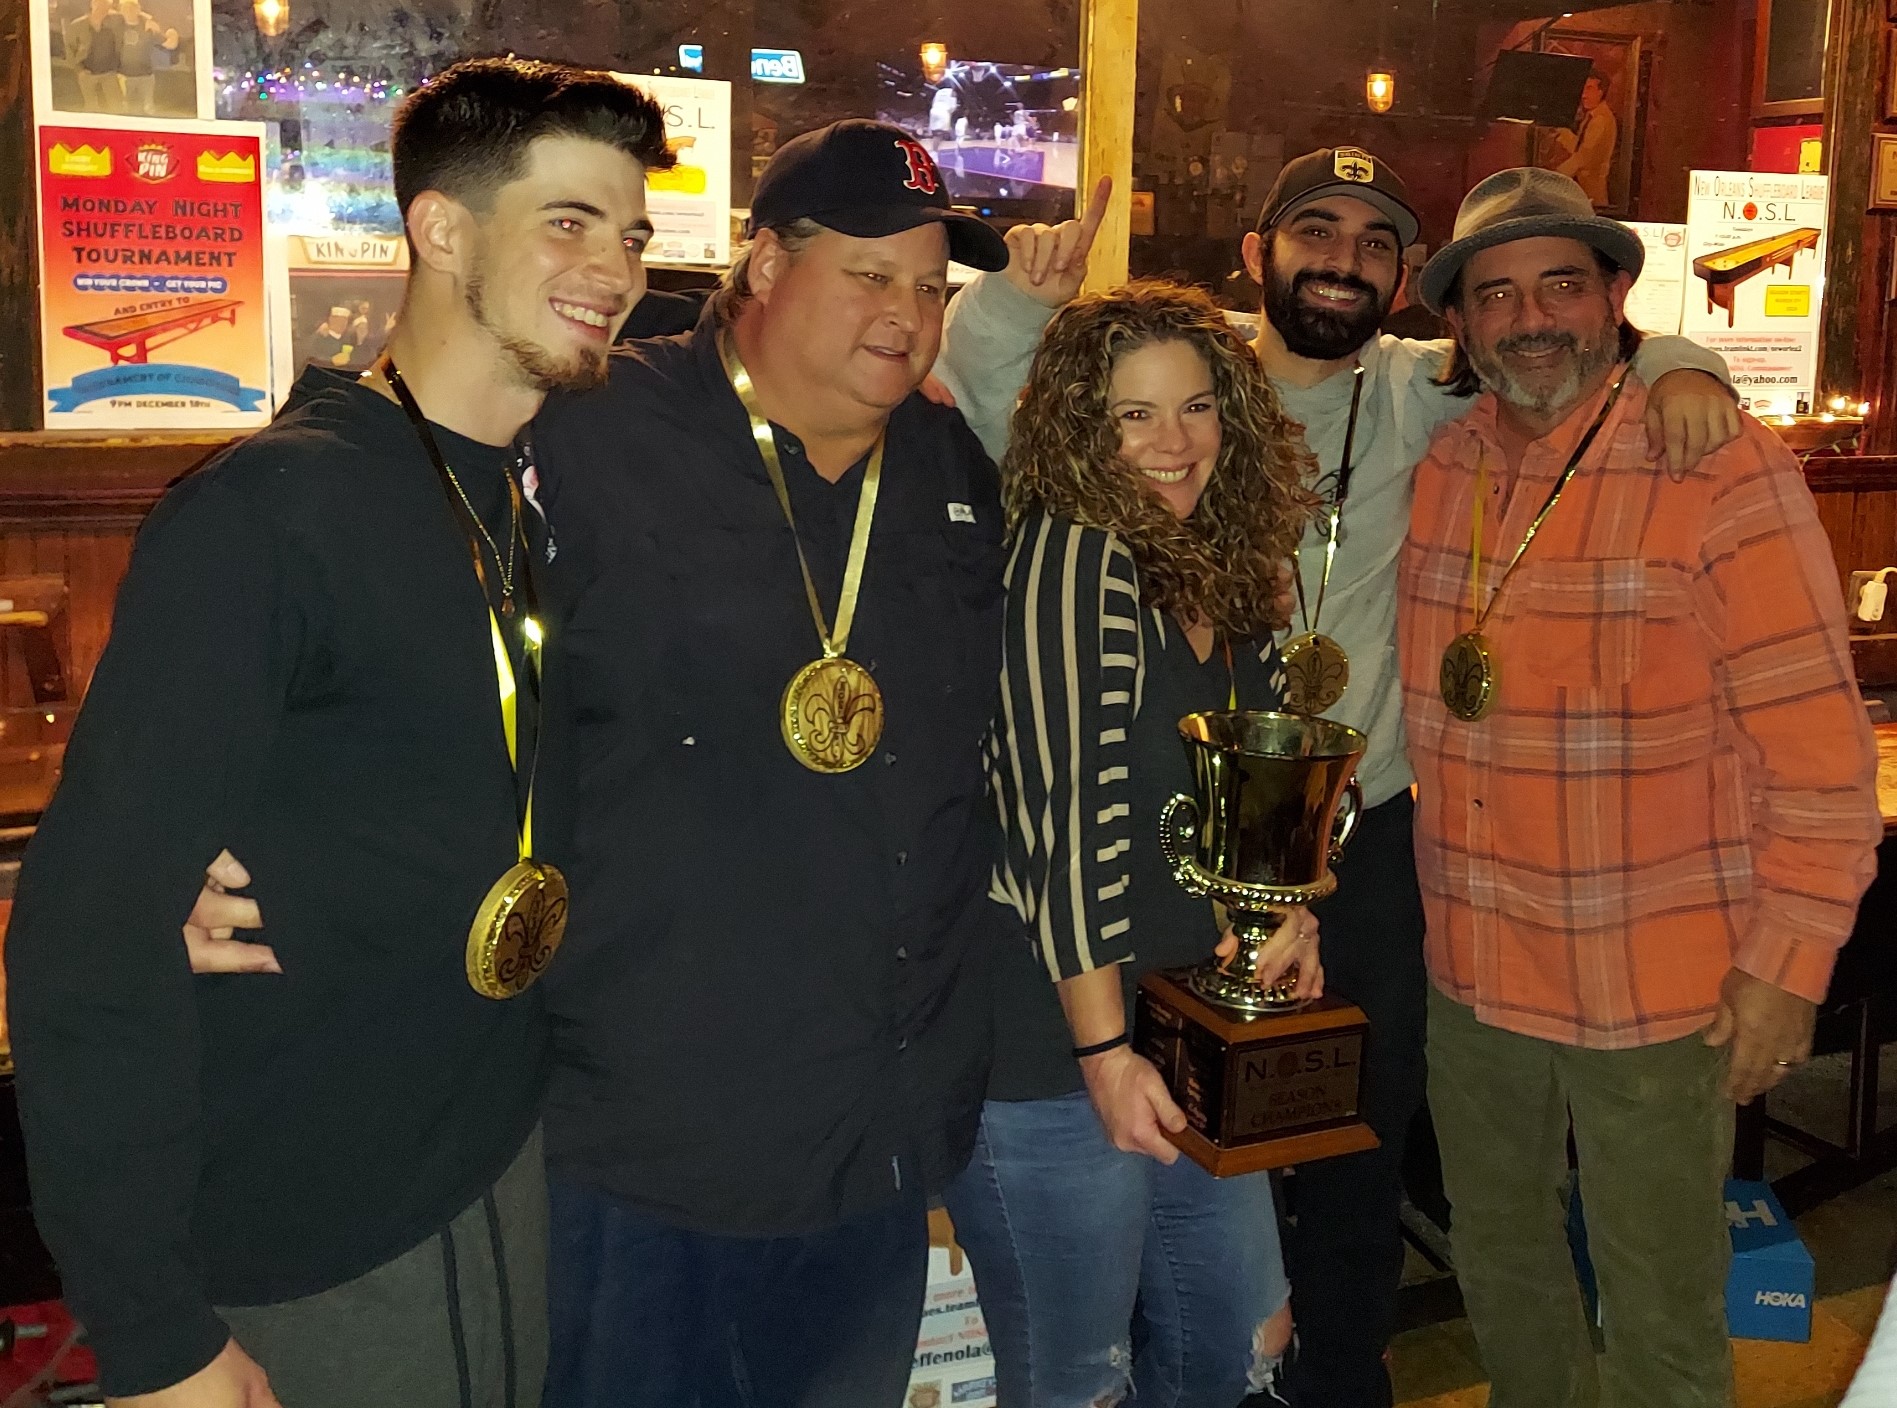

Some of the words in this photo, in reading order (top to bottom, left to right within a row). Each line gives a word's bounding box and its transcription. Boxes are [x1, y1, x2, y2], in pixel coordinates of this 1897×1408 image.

[138, 151, 169, 165] KING
[894, 139, 940, 194] B
[139, 163, 168, 178] PIN
[60, 196, 158, 215] MONDAY
[172, 199, 243, 218] NIGHT
[61, 219, 244, 243] SHUFFLEBOARD
[73, 246, 237, 268] TOURNAMENT
[113, 305, 137, 316] AND
[139, 299, 173, 311] ENTRY
[175, 296, 191, 305] TO
[135, 400, 187, 409] DECEMBER
[1754, 1290, 1806, 1309] HOKA
